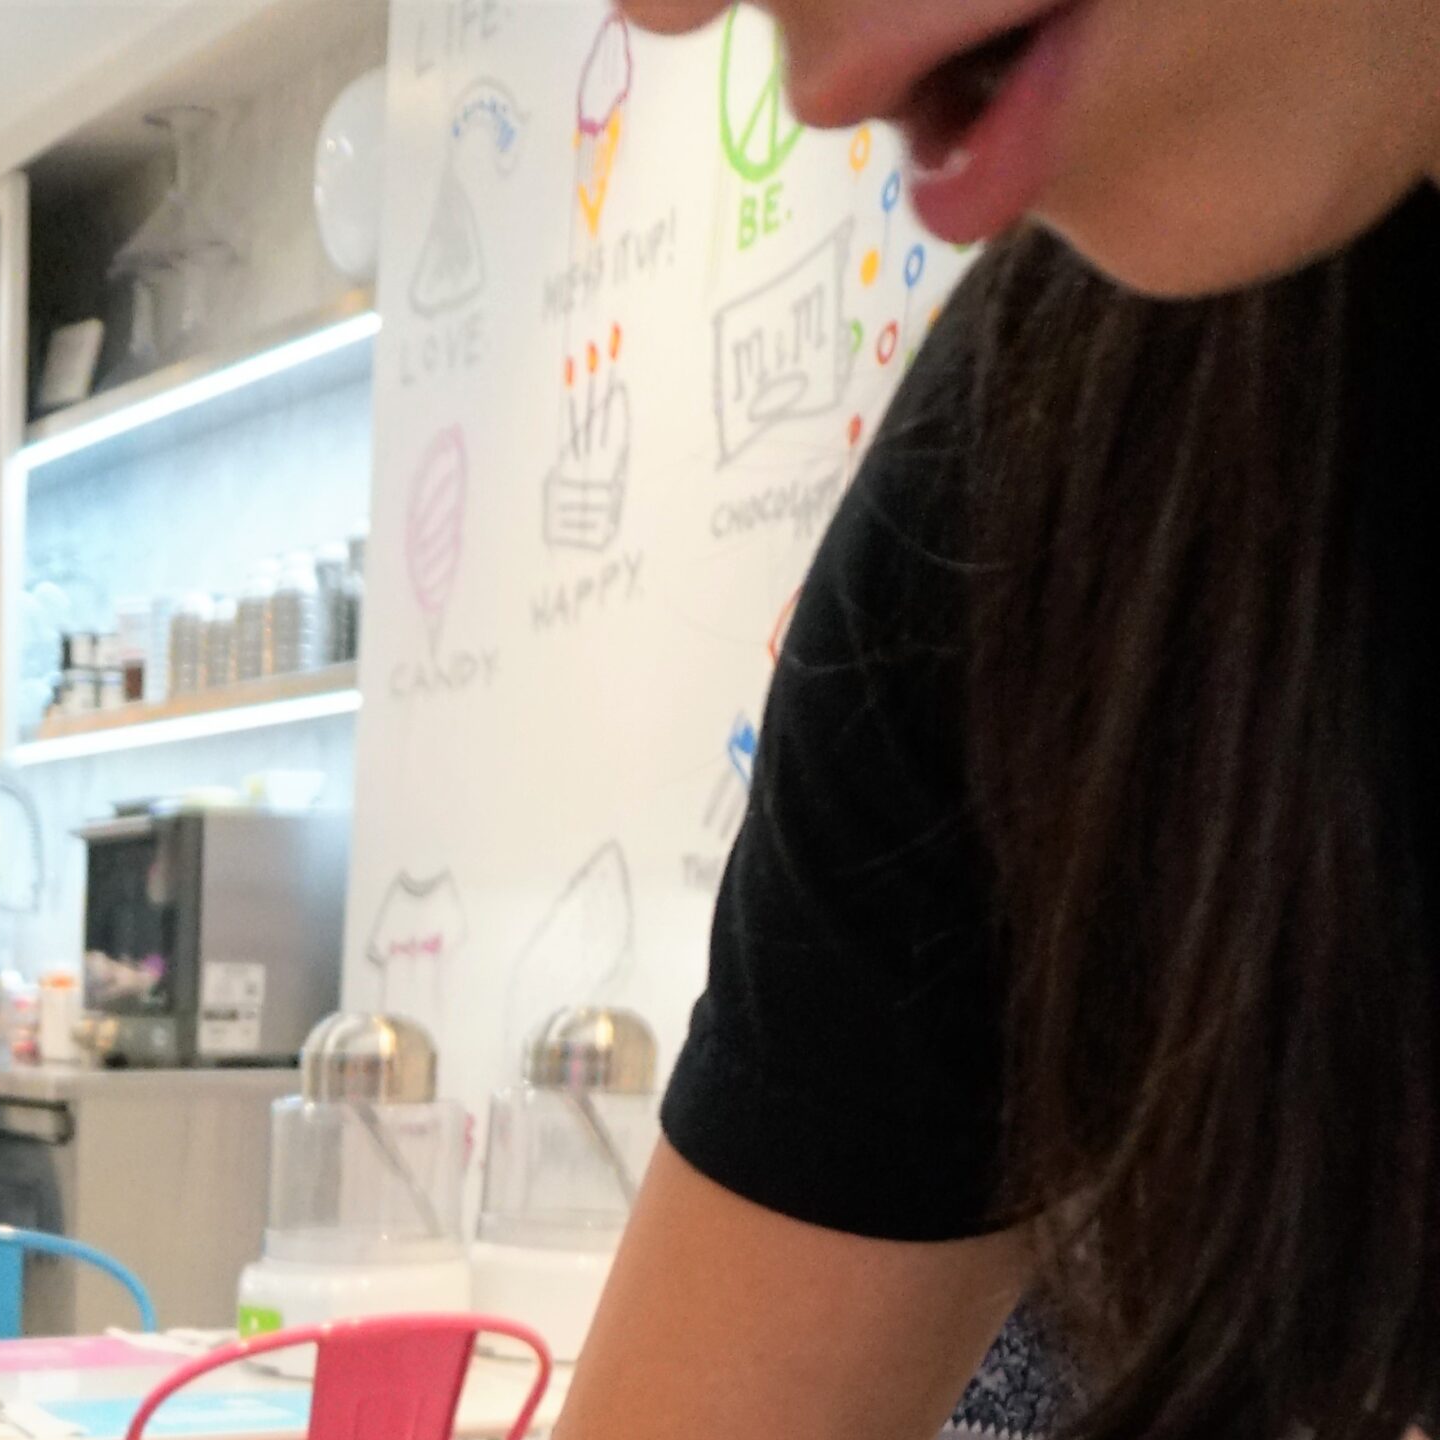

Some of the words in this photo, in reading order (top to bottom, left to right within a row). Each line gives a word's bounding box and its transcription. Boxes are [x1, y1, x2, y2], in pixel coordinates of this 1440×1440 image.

[399, 312, 483, 389] LOVE
[529, 548, 646, 633] HAPPY
[388, 645, 503, 702] CANDY
